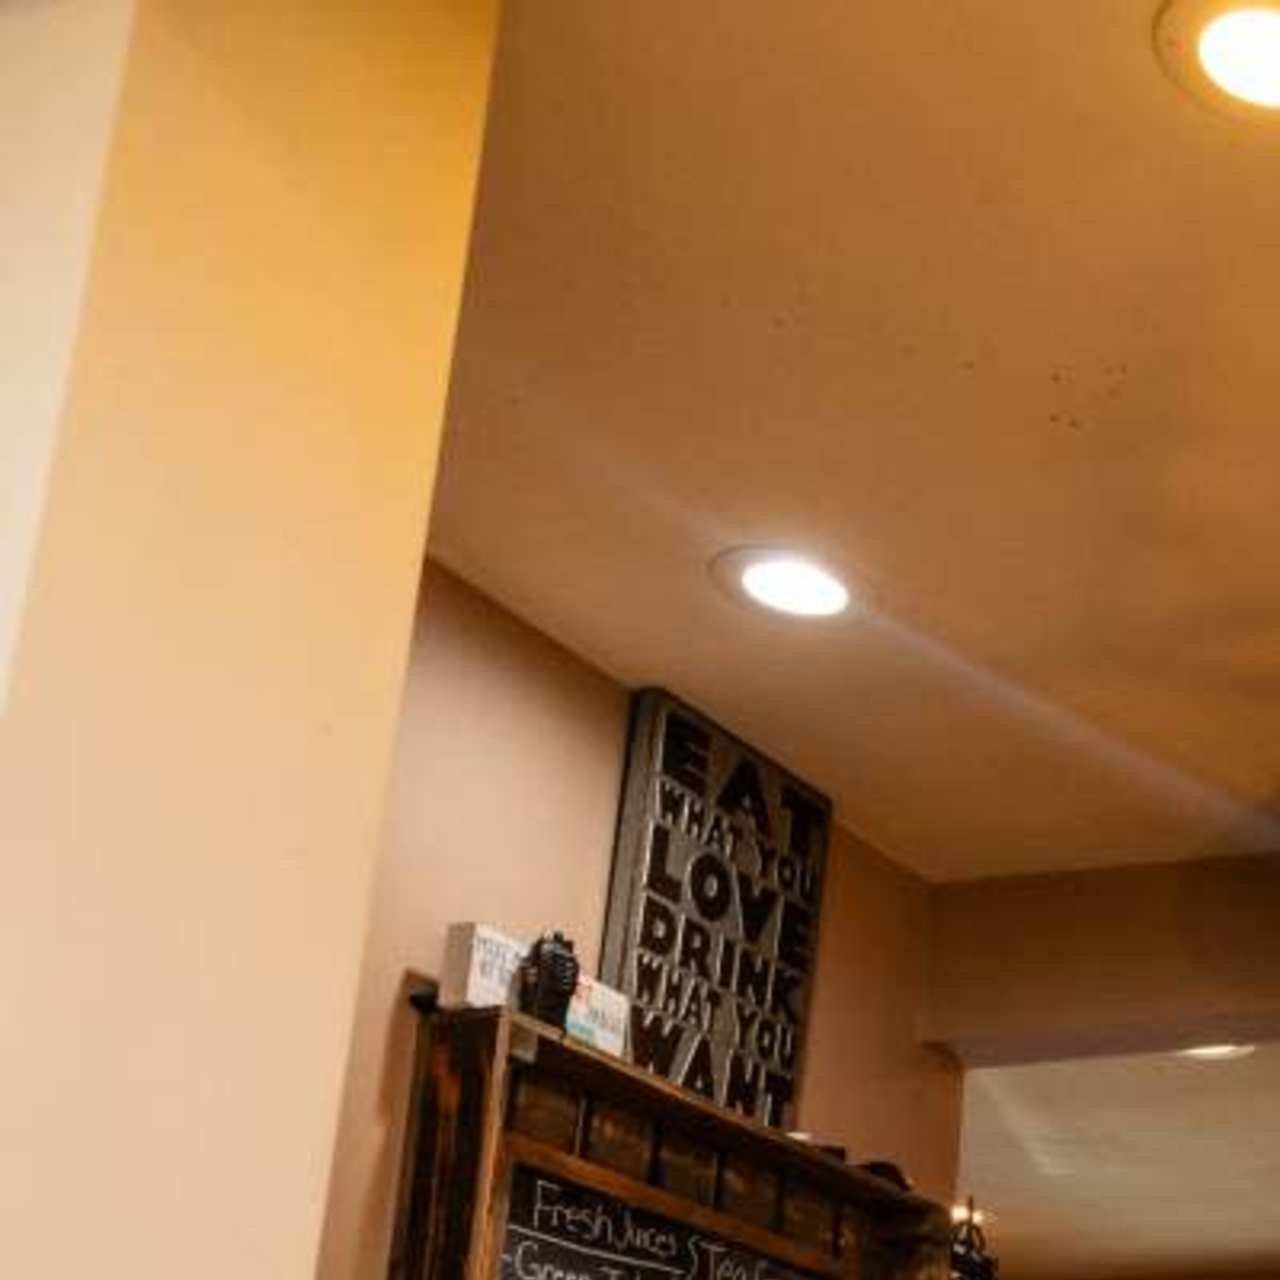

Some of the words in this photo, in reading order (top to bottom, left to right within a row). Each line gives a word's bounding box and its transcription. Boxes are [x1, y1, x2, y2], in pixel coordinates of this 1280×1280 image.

[658, 778, 741, 858] WHAT
[755, 826, 818, 904] YOU
[660, 712, 832, 868] EAT
[646, 824, 813, 972] LOVE
[635, 952, 722, 1030] WHAT
[737, 1002, 795, 1076] YOU
[640, 898, 808, 1026] DRINK
[630, 1003, 796, 1130] WANT
[533, 1179, 614, 1244] Fresh
[614, 1212, 678, 1257] Juices
